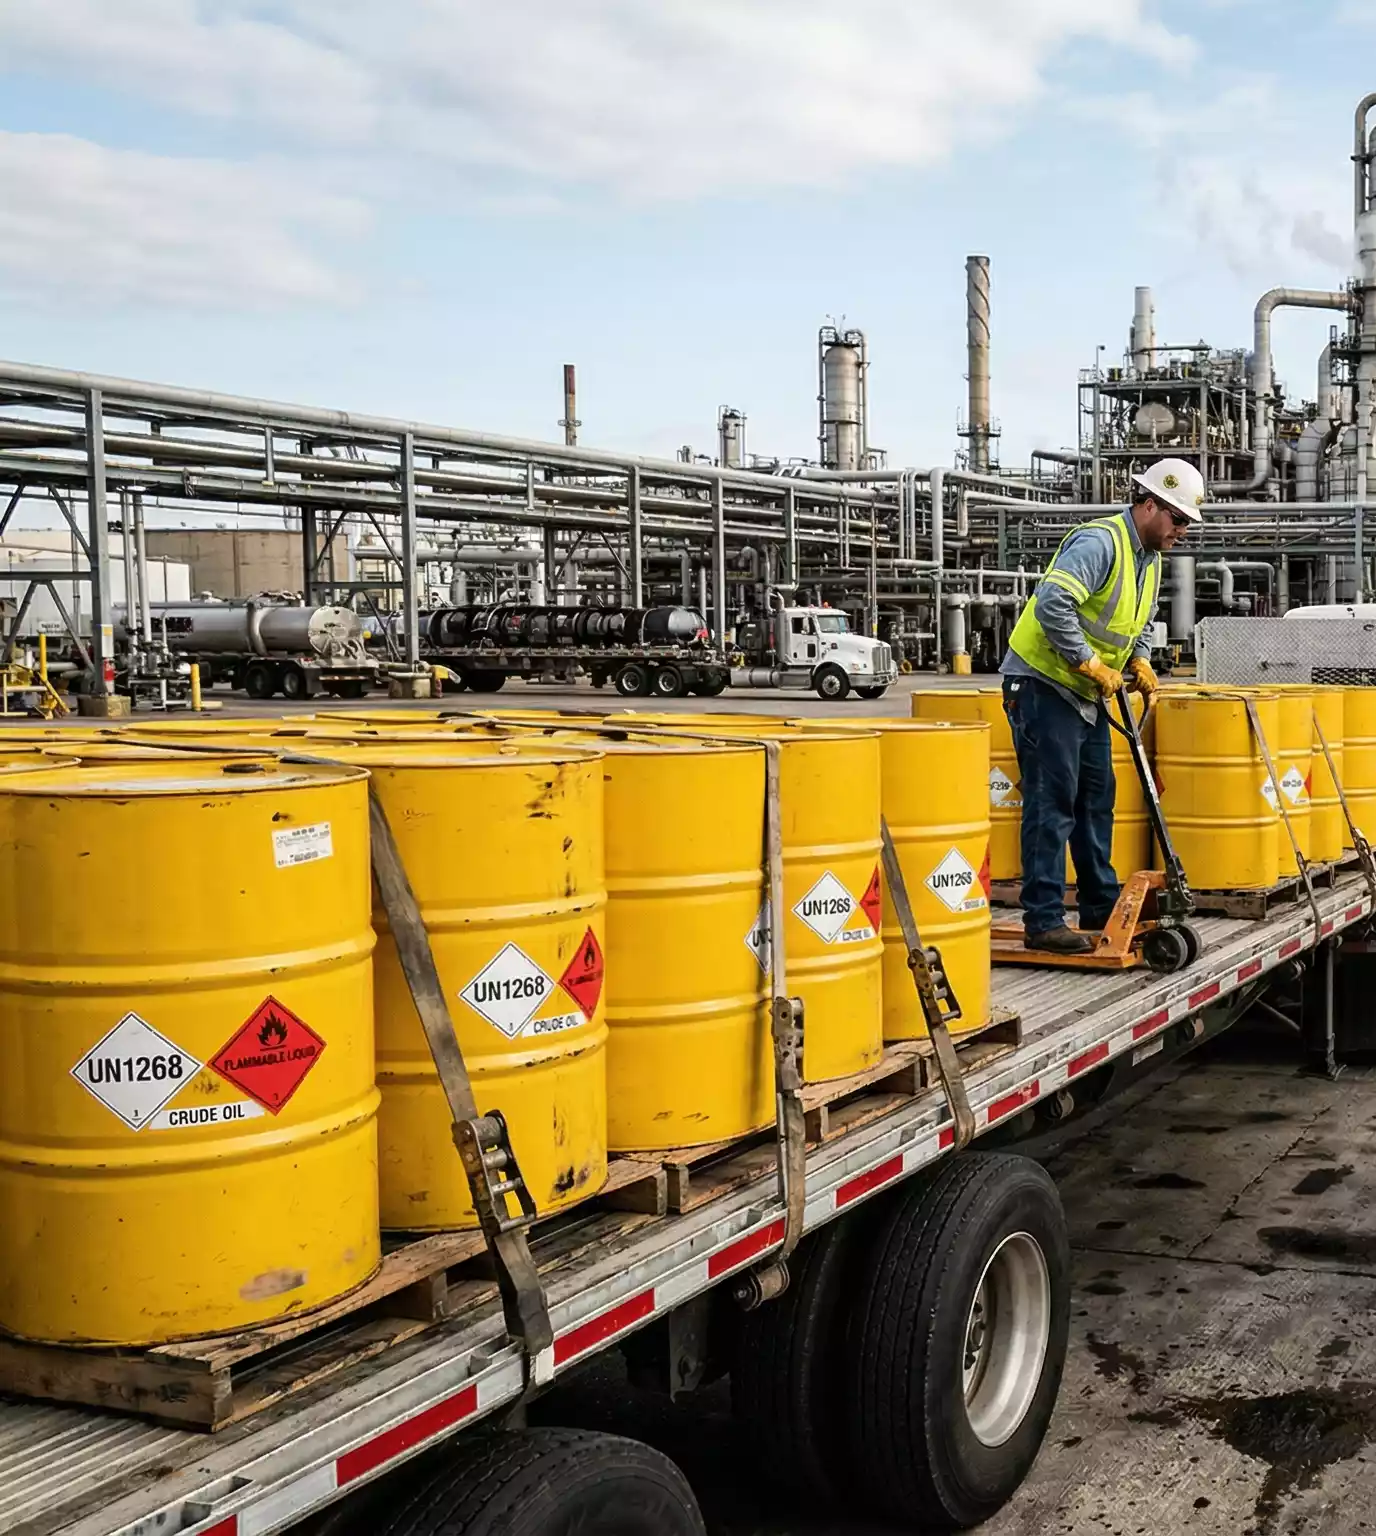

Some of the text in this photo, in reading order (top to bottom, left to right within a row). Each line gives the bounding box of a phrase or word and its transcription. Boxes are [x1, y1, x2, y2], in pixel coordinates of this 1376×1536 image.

[474, 975, 545, 1003] UN1268
[87, 1054, 183, 1084] UN1268
[168, 1104, 245, 1126] CRUDE OIL
